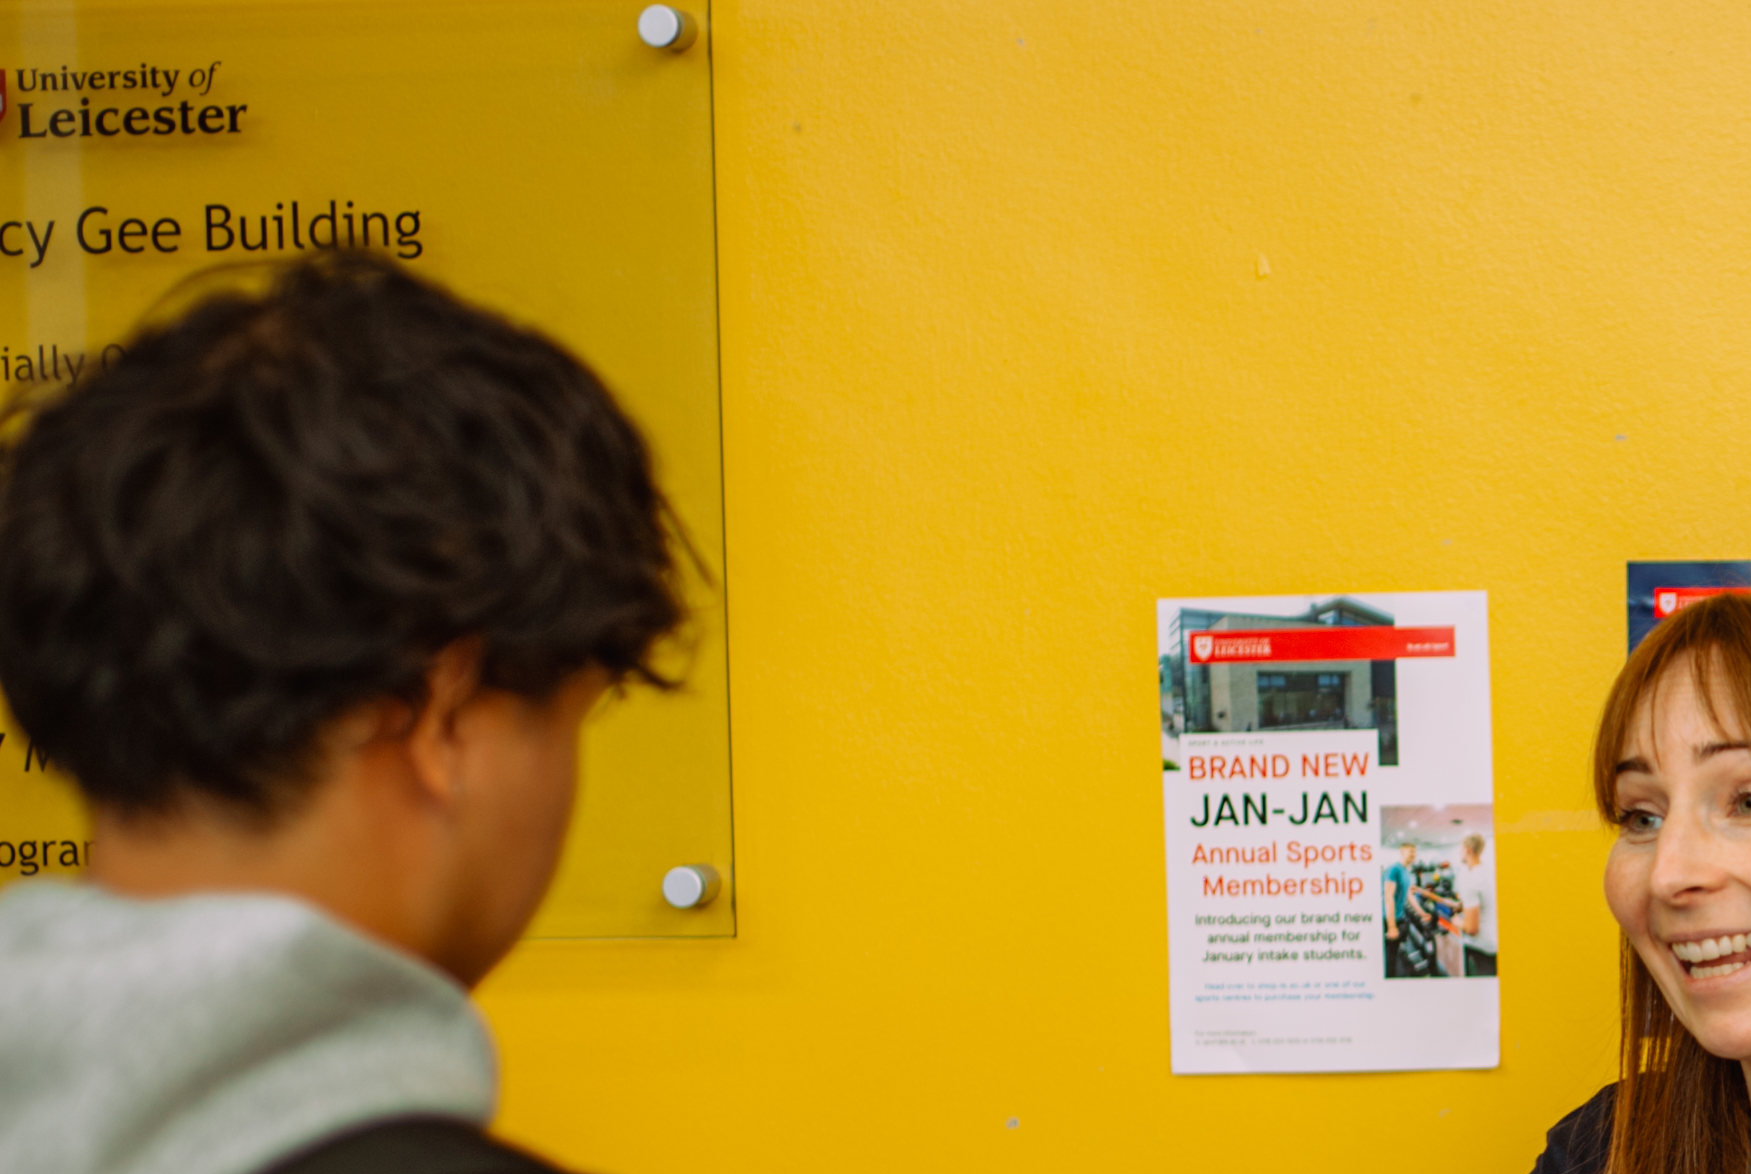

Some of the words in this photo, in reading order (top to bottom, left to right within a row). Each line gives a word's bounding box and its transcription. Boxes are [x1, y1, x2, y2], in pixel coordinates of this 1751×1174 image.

[15, 63, 180, 98] University
[188, 61, 221, 96] of
[17, 97, 248, 139] Leicester
[76, 206, 182, 255] Gee
[205, 200, 424, 260] Building
[1188, 754, 1290, 780] BRAND
[1301, 752, 1369, 777] NEW
[1190, 790, 1368, 828] JAN-JAN
[1191, 840, 1278, 865] Annual
[1286, 840, 1373, 869] Sports
[1202, 871, 1364, 901] Membership
[1195, 912, 1271, 928] Introducing
[1275, 914, 1297, 924] our
[1301, 912, 1340, 925] brand
[1344, 913, 1373, 923] new
[1207, 931, 1250, 944] annual
[1253, 930, 1337, 944] membership
[1341, 929, 1361, 941] for
[1202, 950, 1253, 966] January
[1257, 948, 1299, 961] intake
[1303, 948, 1367, 961] students.
